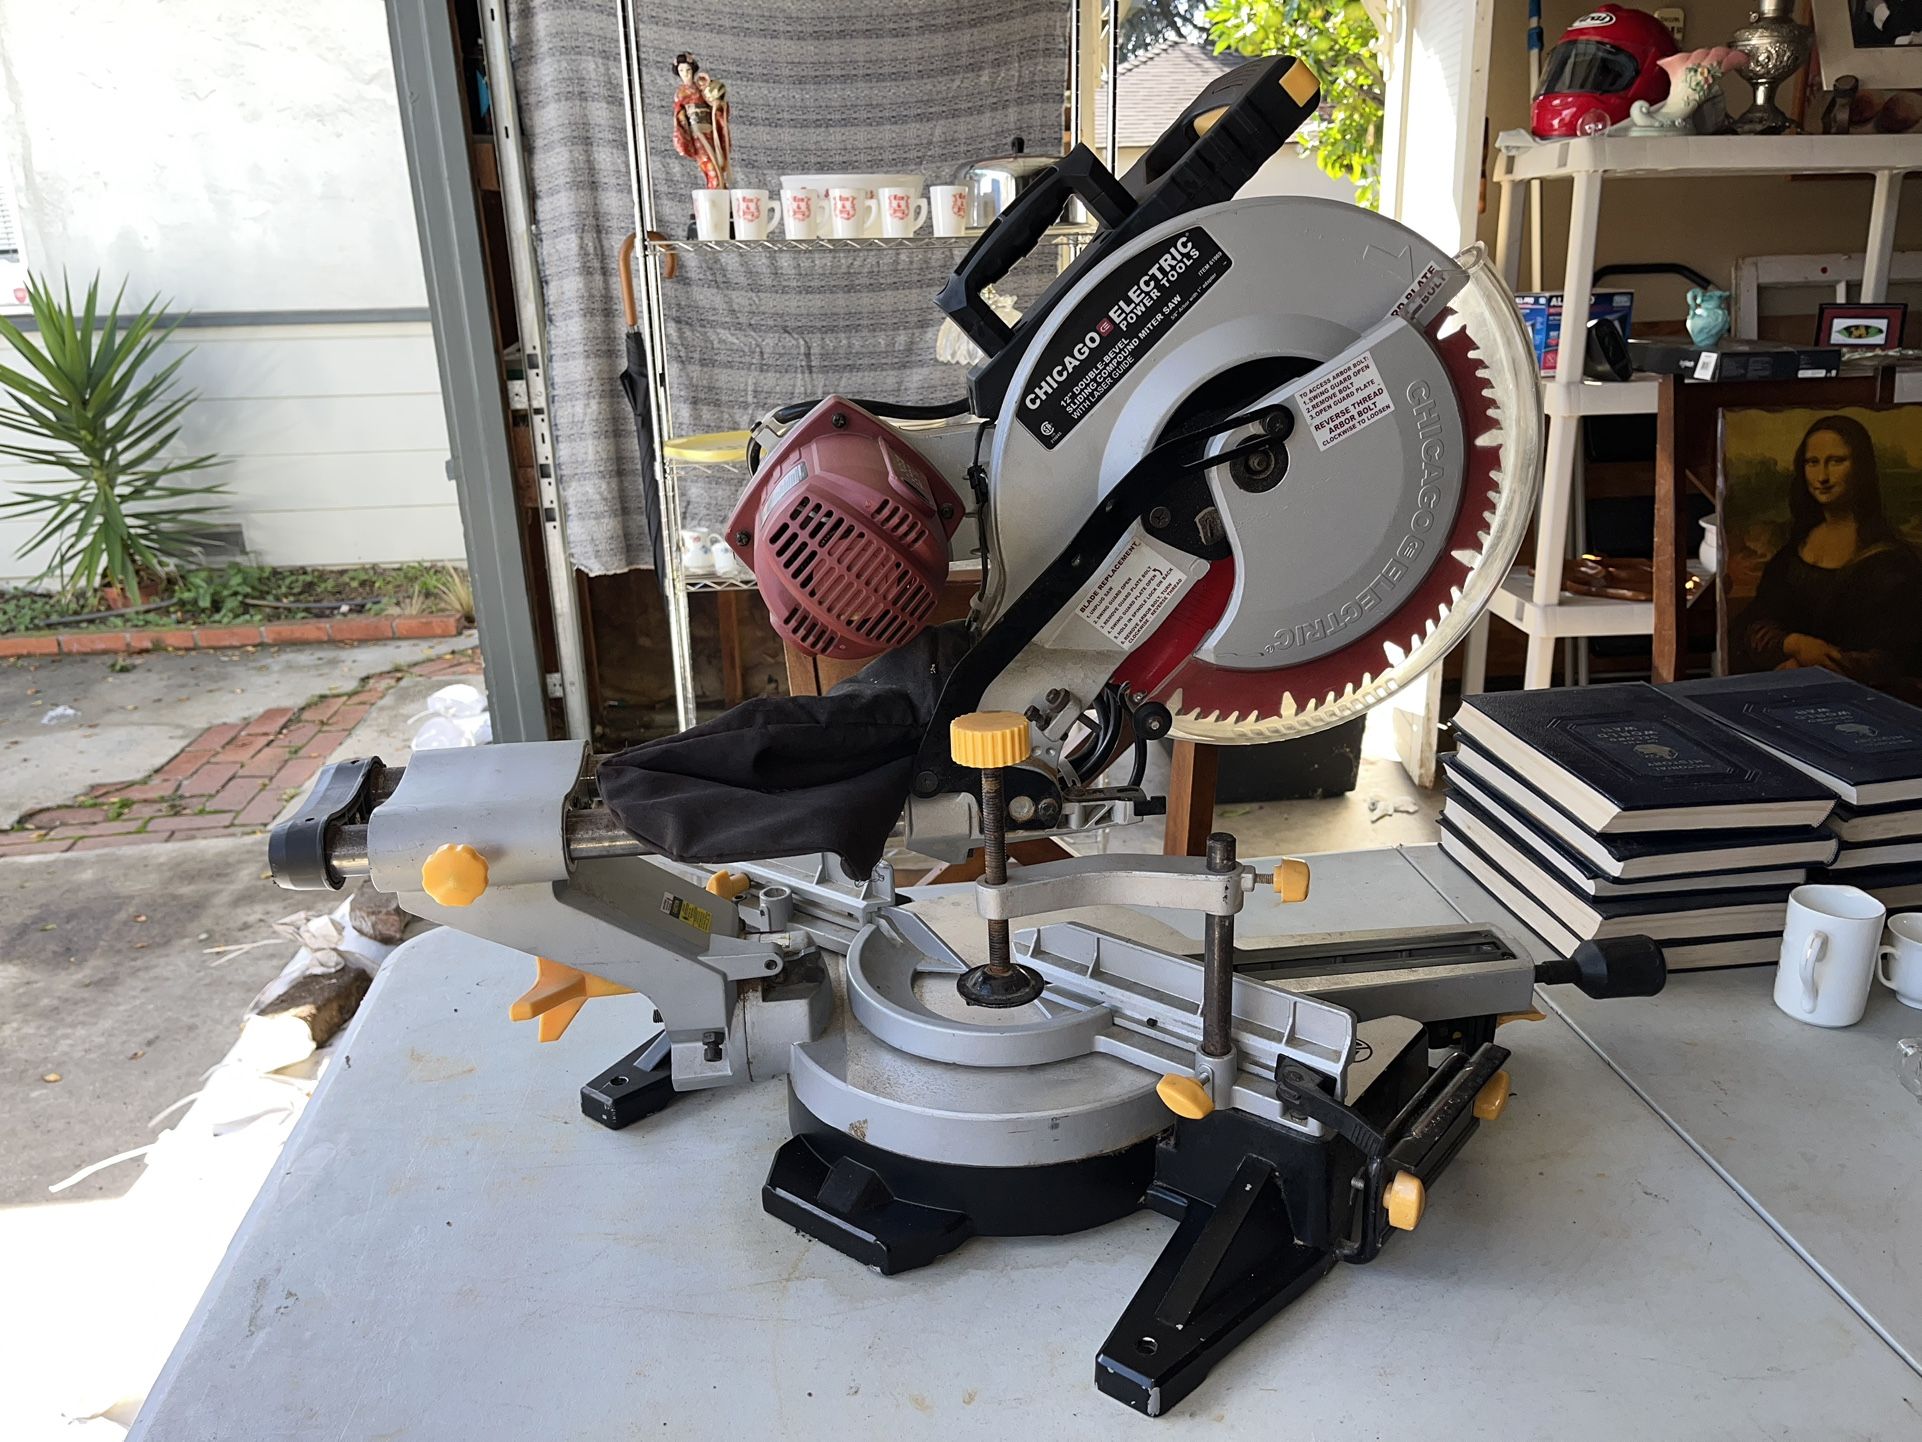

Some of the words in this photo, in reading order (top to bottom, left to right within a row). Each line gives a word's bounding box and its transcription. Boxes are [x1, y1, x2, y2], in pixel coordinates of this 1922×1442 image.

[1119, 289, 1161, 331] POWER
[1160, 248, 1199, 287] TOOLS
[1025, 332, 1100, 409] CHICAGO
[1108, 237, 1192, 324] ELECTRIC
[1061, 392, 1073, 406] 12"
[1073, 338, 1129, 394] DOUBLE-BEVEL
[1066, 381, 1097, 413] SLIDING
[1096, 338, 1139, 382] COMPOUND
[1138, 313, 1164, 339] MITER
[1163, 294, 1181, 314] SAW
[1309, 378, 1331, 394] ACCESS
[1332, 366, 1352, 380] ARBOR
[1330, 374, 1352, 390] GUARD
[1352, 364, 1370, 377] OPEN
[1071, 400, 1091, 419] WITH
[1089, 377, 1113, 402] LASER
[1112, 355, 1134, 378] GUIDE
[1314, 406, 1351, 431] REVERSE
[1351, 388, 1383, 409] THREAD
[1333, 391, 1355, 406] GUARD
[1355, 379, 1375, 393] PLATE
[1338, 381, 1354, 395] BOLT
[1322, 423, 1357, 446] CLOCKWISE
[1366, 404, 1390, 421] LOOSEN
[1329, 414, 1356, 434] ARBOR
[1357, 401, 1377, 418] BOLT
[1406, 379, 1445, 533] CHICAGO
[1079, 590, 1099, 613] BLADE
[1097, 541, 1139, 590] REPLACEMENT
[1096, 605, 1109, 620] SWING
[1108, 590, 1122, 605] GUARD
[1120, 577, 1132, 590] OPEN
[1103, 607, 1119, 625] REMOVE
[1118, 592, 1131, 607] GUARD
[1130, 578, 1142, 592] PLATE
[1141, 566, 1151, 578] BOLT
[1104, 586, 1113, 597] SAW
[1110, 615, 1123, 630] SWING
[1122, 600, 1135, 615] GUARD
[1134, 587, 1147, 600] PLATE
[1145, 574, 1157, 587] OPEN
[1117, 623, 1128, 635] HOLD
[1131, 599, 1147, 618] SPINDLE
[1146, 587, 1157, 600] LOCK
[1162, 568, 1173, 580] BACK
[1273, 558, 1409, 653] ELECTRIC
[1124, 622, 1139, 640] REMOVE
[1139, 607, 1152, 623] ARBOR
[1160, 583, 1172, 595] TURN
[1128, 619, 1149, 643] CLOCKWISE
[1151, 596, 1168, 616] REVERSE
[1166, 578, 1182, 596] THREAD
